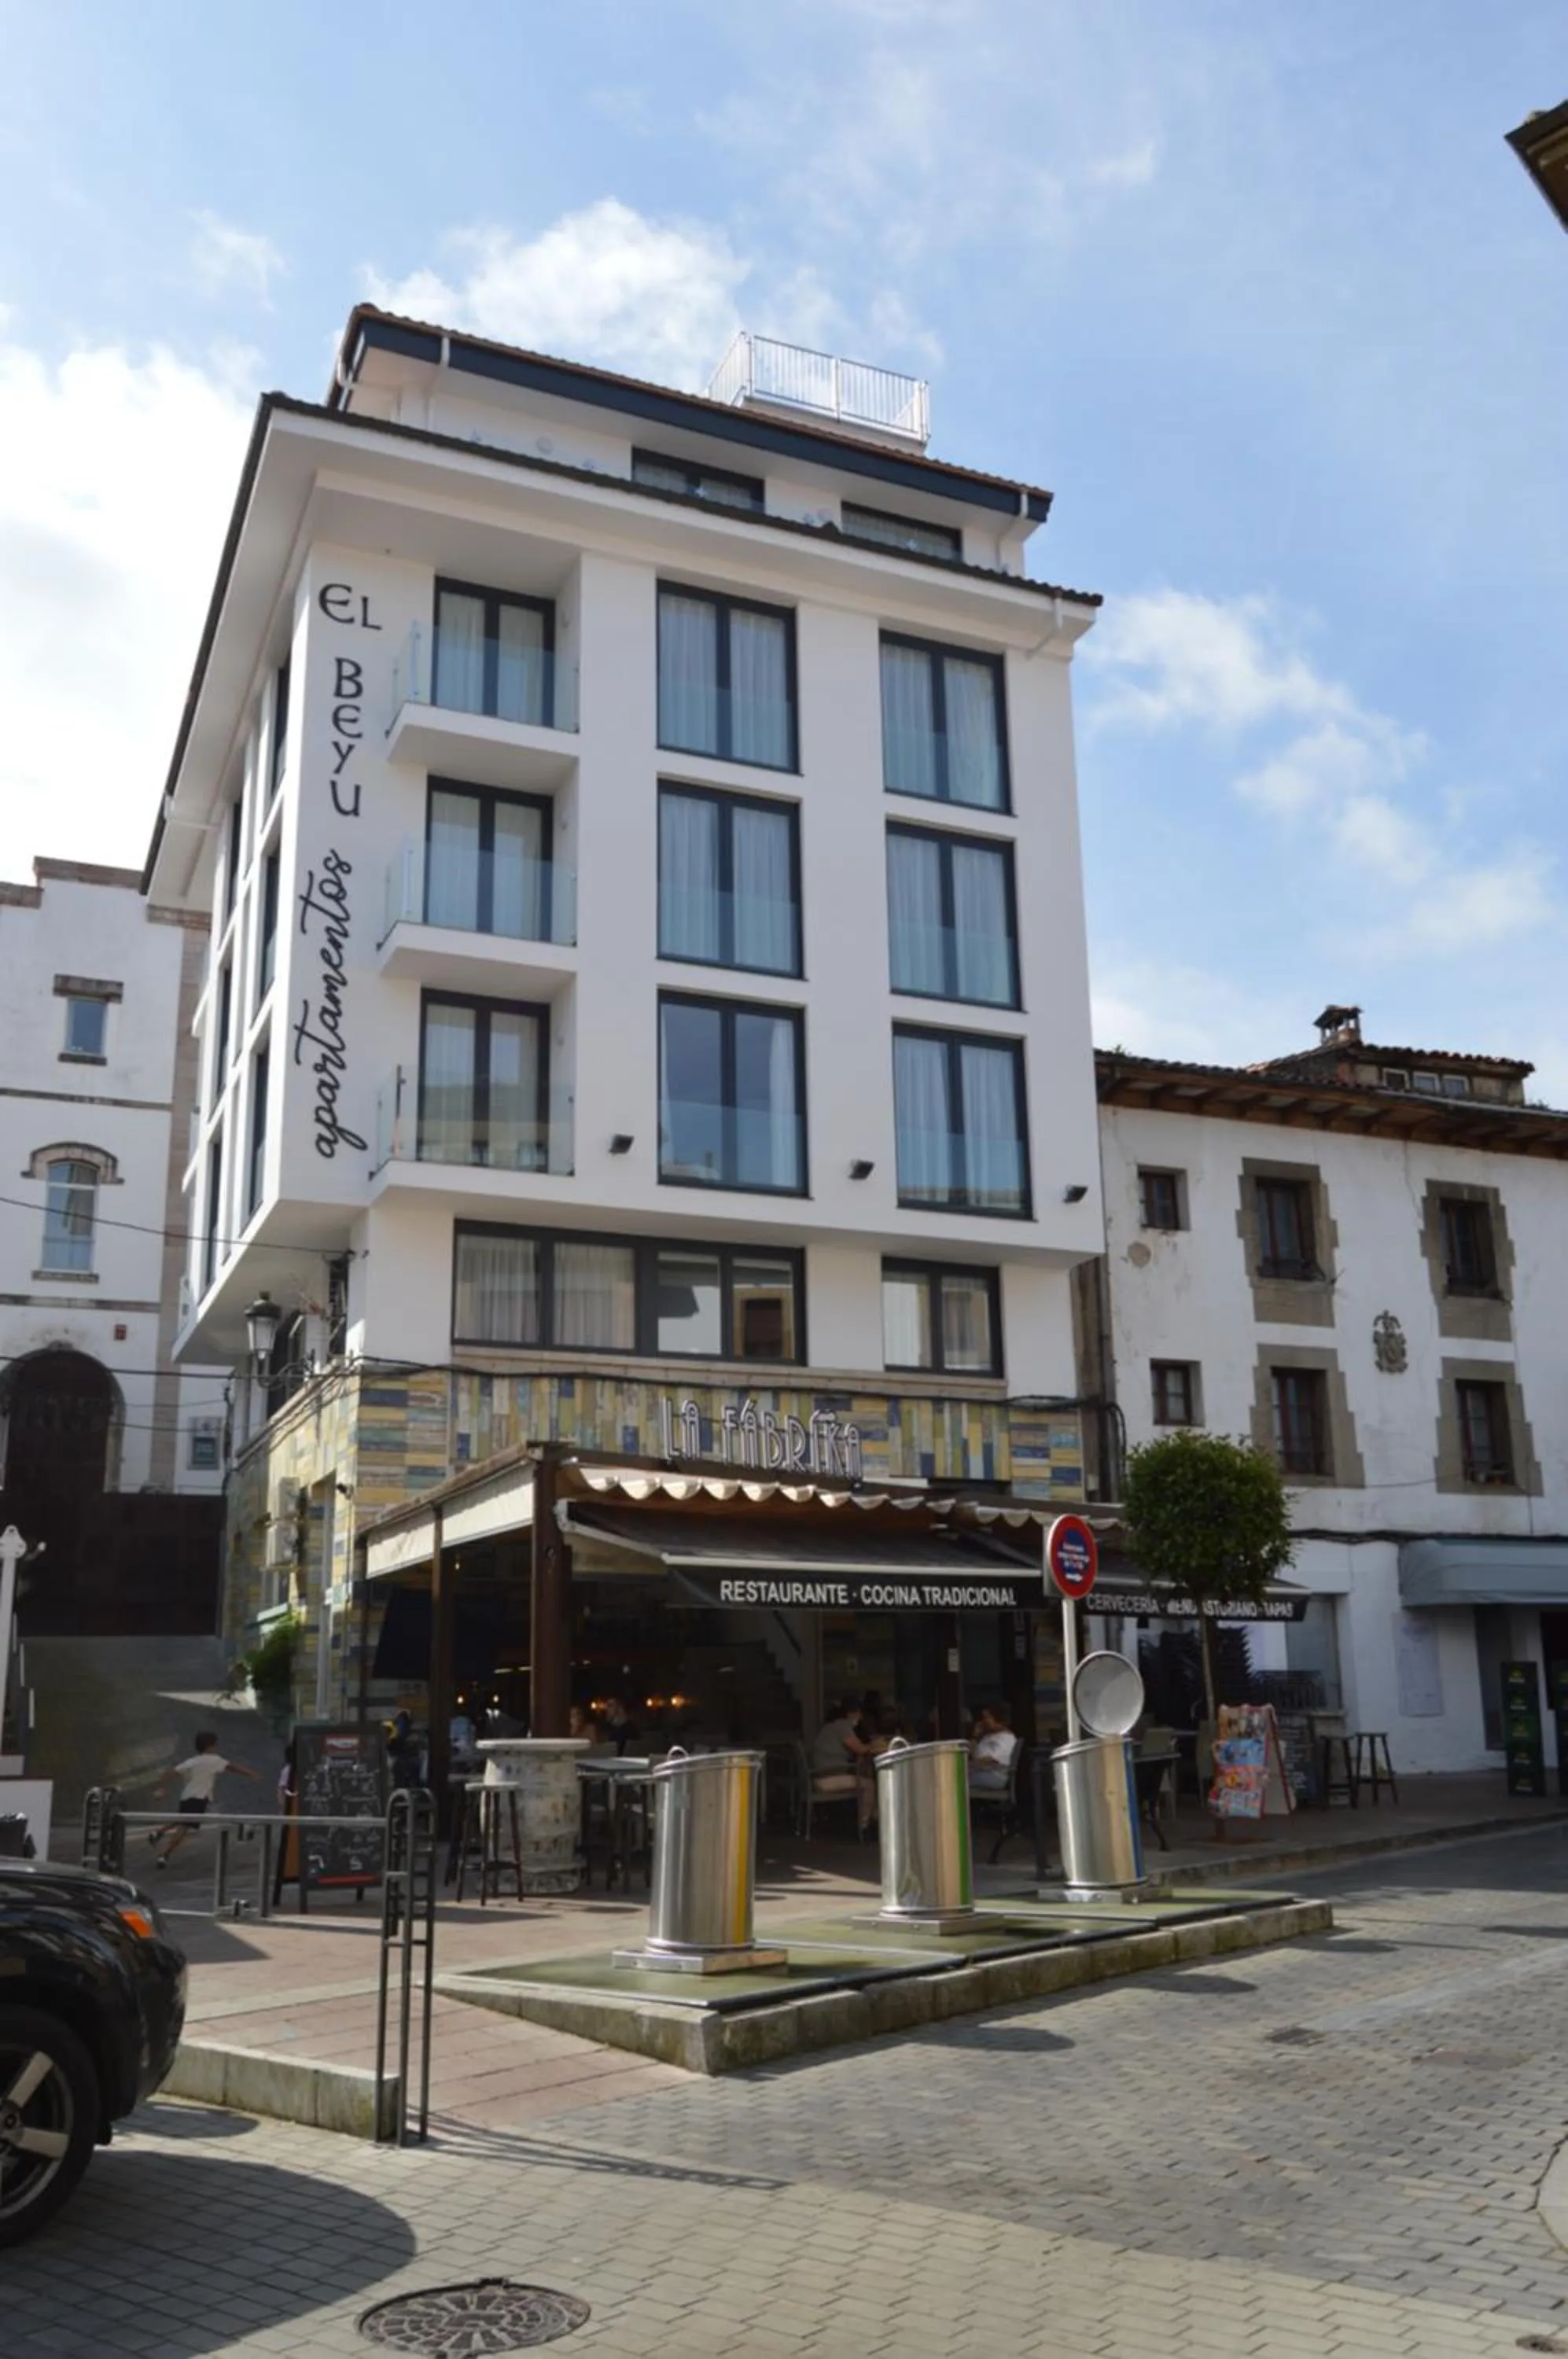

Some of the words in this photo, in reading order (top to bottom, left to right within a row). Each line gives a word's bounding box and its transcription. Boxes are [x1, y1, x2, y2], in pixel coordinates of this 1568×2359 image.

[318, 583, 383, 631] EL
[329, 656, 364, 818] BEYU
[293, 848, 368, 1159] apartamentos
[661, 1396, 702, 1461] LA
[720, 1580, 849, 1605] RESTAURANTE
[860, 1584, 921, 1606] COCINA
[924, 1586, 1017, 1606] TRADICIONAL
